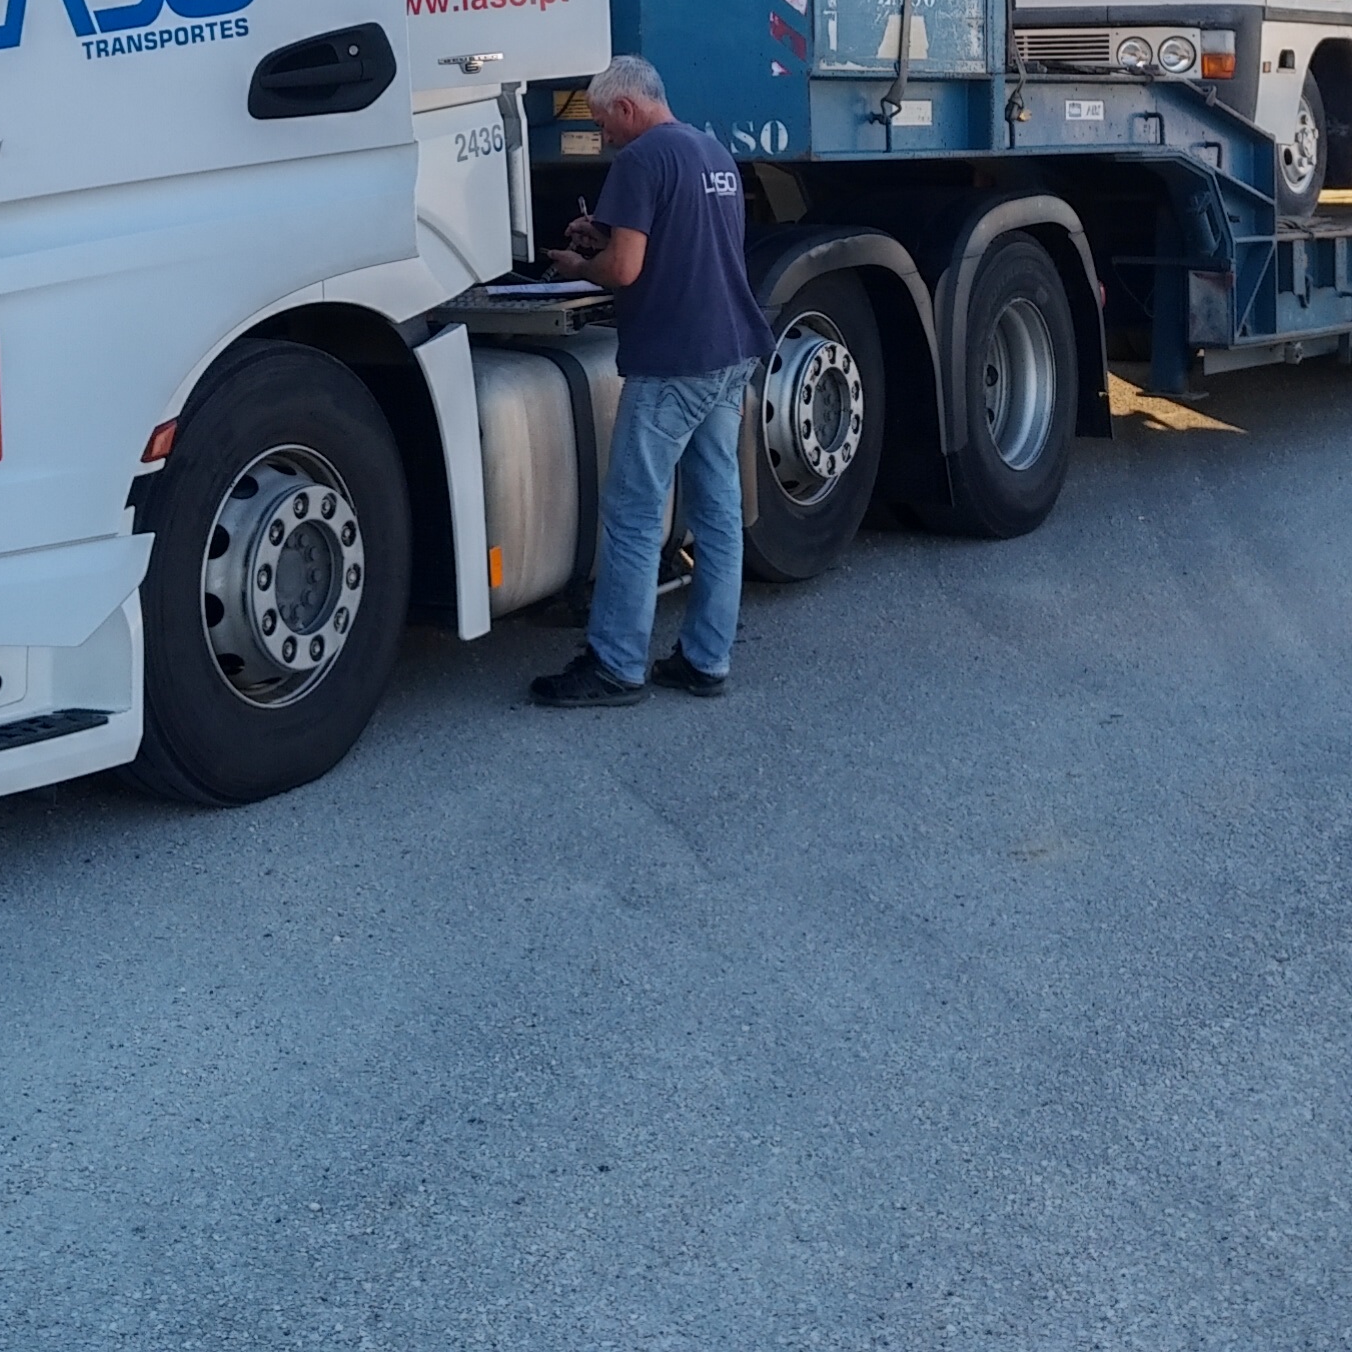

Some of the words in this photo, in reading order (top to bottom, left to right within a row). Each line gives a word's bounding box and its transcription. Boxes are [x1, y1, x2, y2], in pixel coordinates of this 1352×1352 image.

[82, 17, 249, 60] TRANSPORTES
[455, 125, 504, 163] 2436
[705, 120, 789, 156] SO
